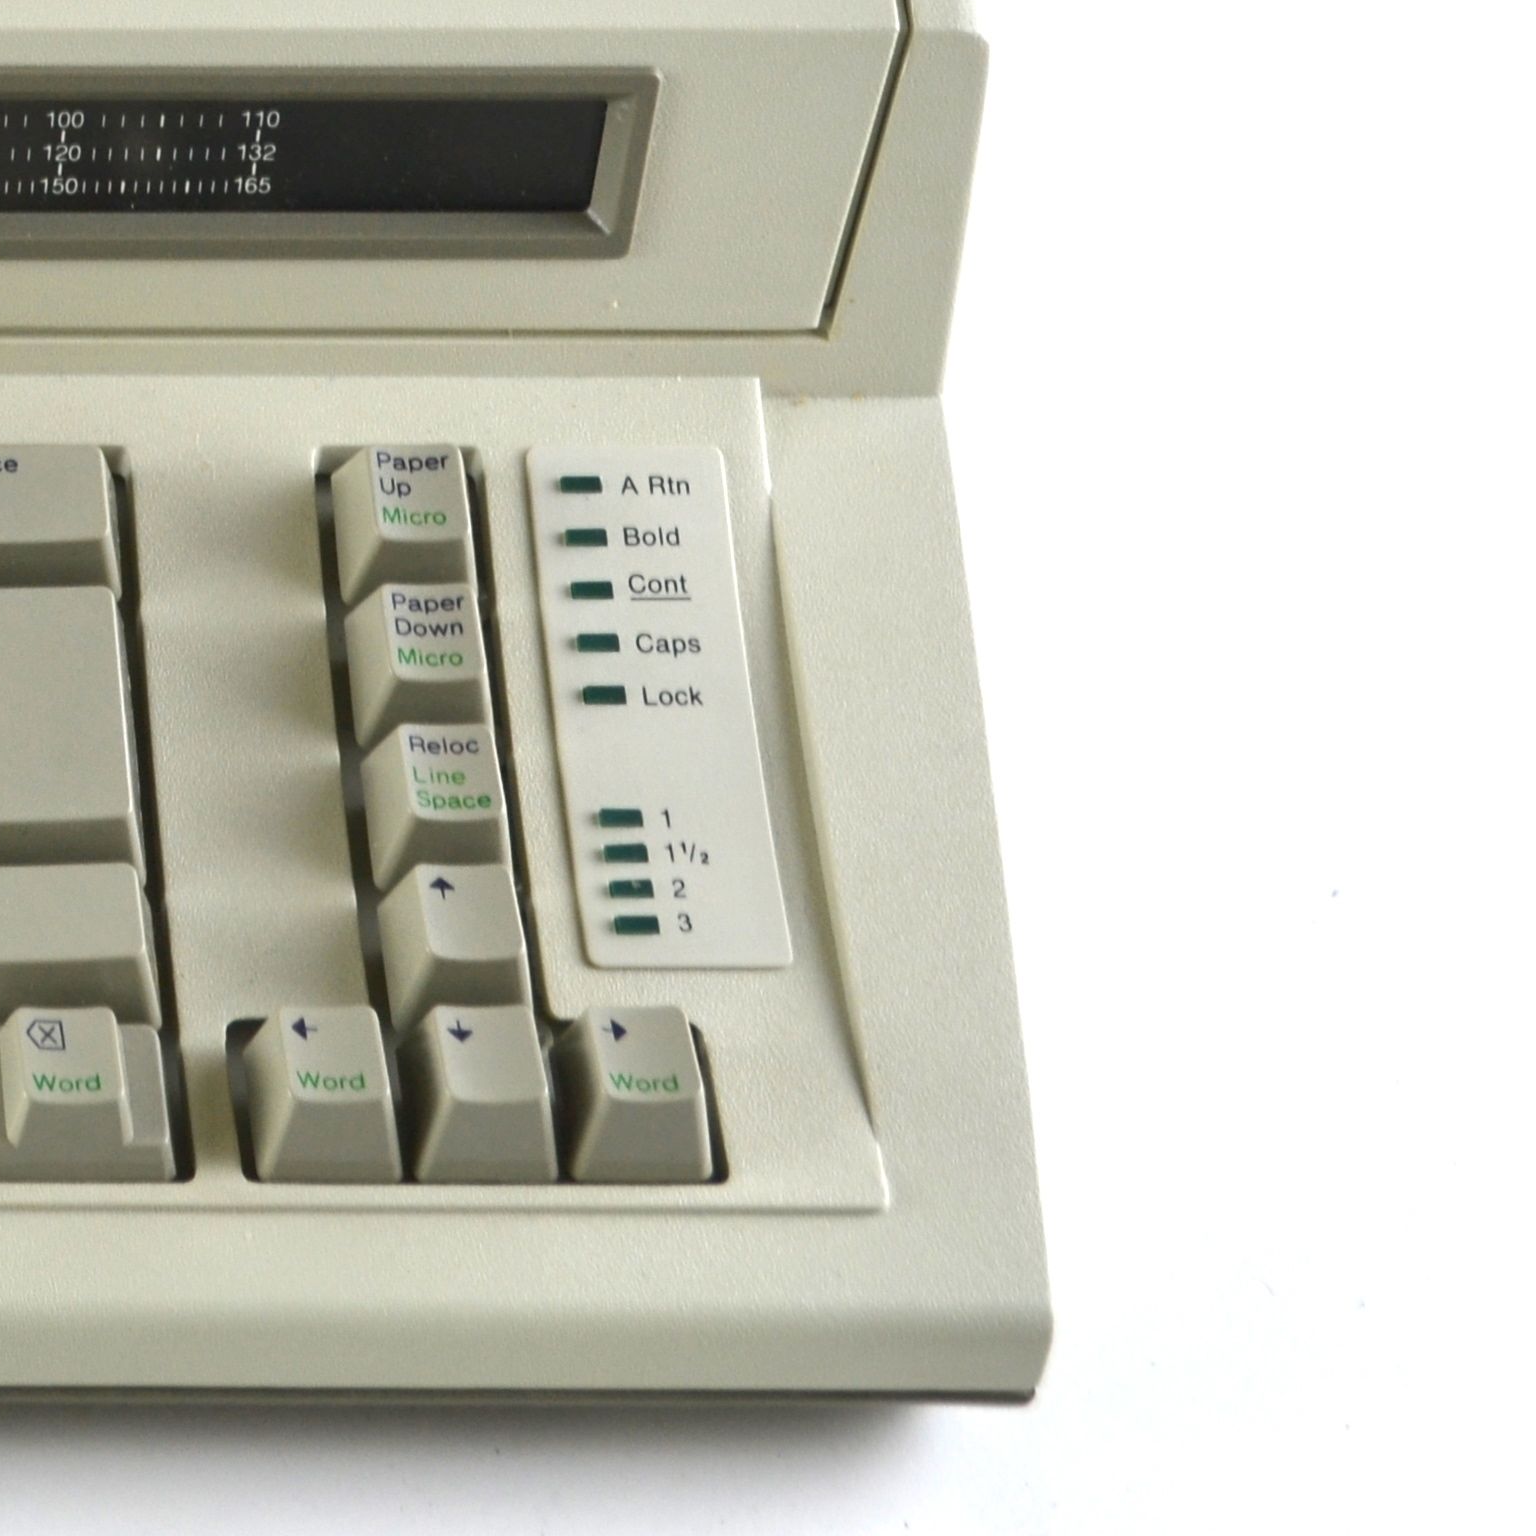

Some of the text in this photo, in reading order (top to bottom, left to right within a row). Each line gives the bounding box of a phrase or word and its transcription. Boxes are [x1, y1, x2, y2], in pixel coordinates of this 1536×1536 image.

[47, 111, 85, 129] 100
[242, 110, 281, 132] 110
[44, 144, 82, 162] 120
[238, 143, 277, 165] 132
[41, 177, 79, 194] 150
[235, 176, 271, 194] 165
[376, 451, 449, 474] Paper
[379, 477, 412, 499] Up
[621, 475, 690, 495] A Rtn
[382, 506, 448, 527] Micro
[622, 526, 680, 547] Bold
[628, 573, 687, 595] Cont
[391, 593, 465, 615] Paper
[395, 617, 464, 638] Down
[635, 633, 702, 658] Caps
[397, 647, 464, 668] Micro
[641, 685, 703, 706] Lock
[408, 735, 480, 756] Reloc
[412, 766, 467, 787] Line
[417, 791, 493, 811] Space
[662, 808, 671, 828] 1
[671, 878, 687, 899] 2
[677, 913, 693, 933] 3
[32, 1073, 102, 1092] Word
[297, 1071, 367, 1092] Word
[610, 1073, 681, 1094] Word
